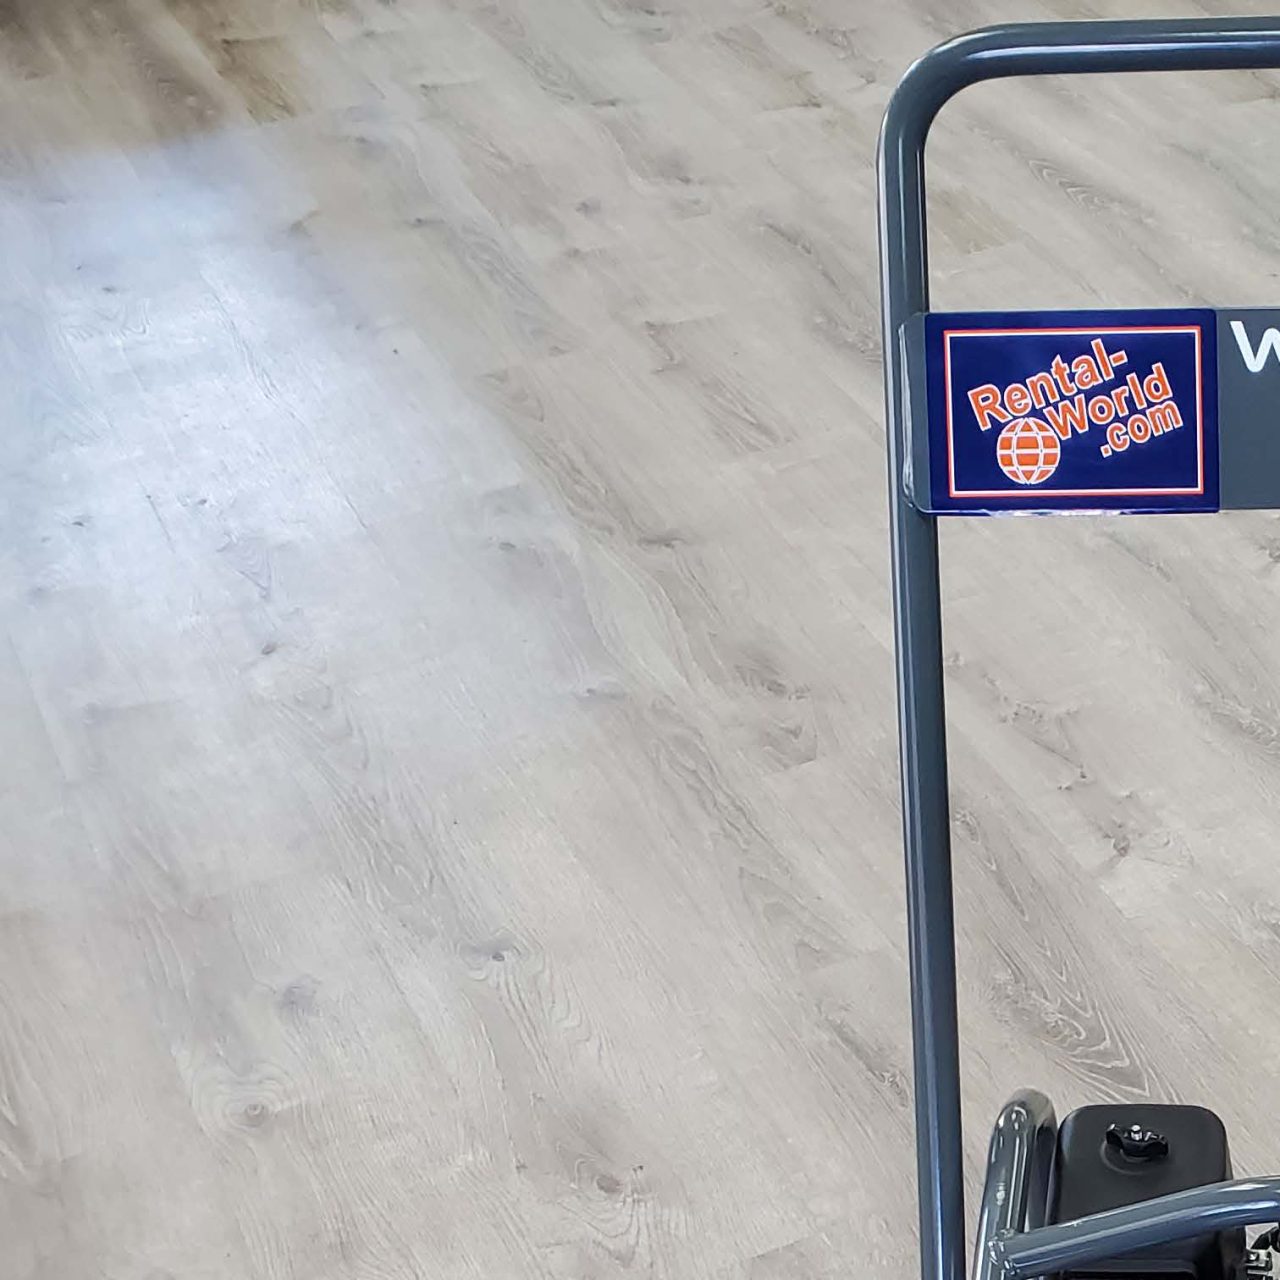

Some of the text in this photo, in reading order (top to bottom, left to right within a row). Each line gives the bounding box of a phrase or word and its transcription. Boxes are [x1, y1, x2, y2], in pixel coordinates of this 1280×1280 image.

[967, 338, 1128, 431] Rental-
[1043, 362, 1173, 440] World
[1100, 400, 1183, 458] .com
